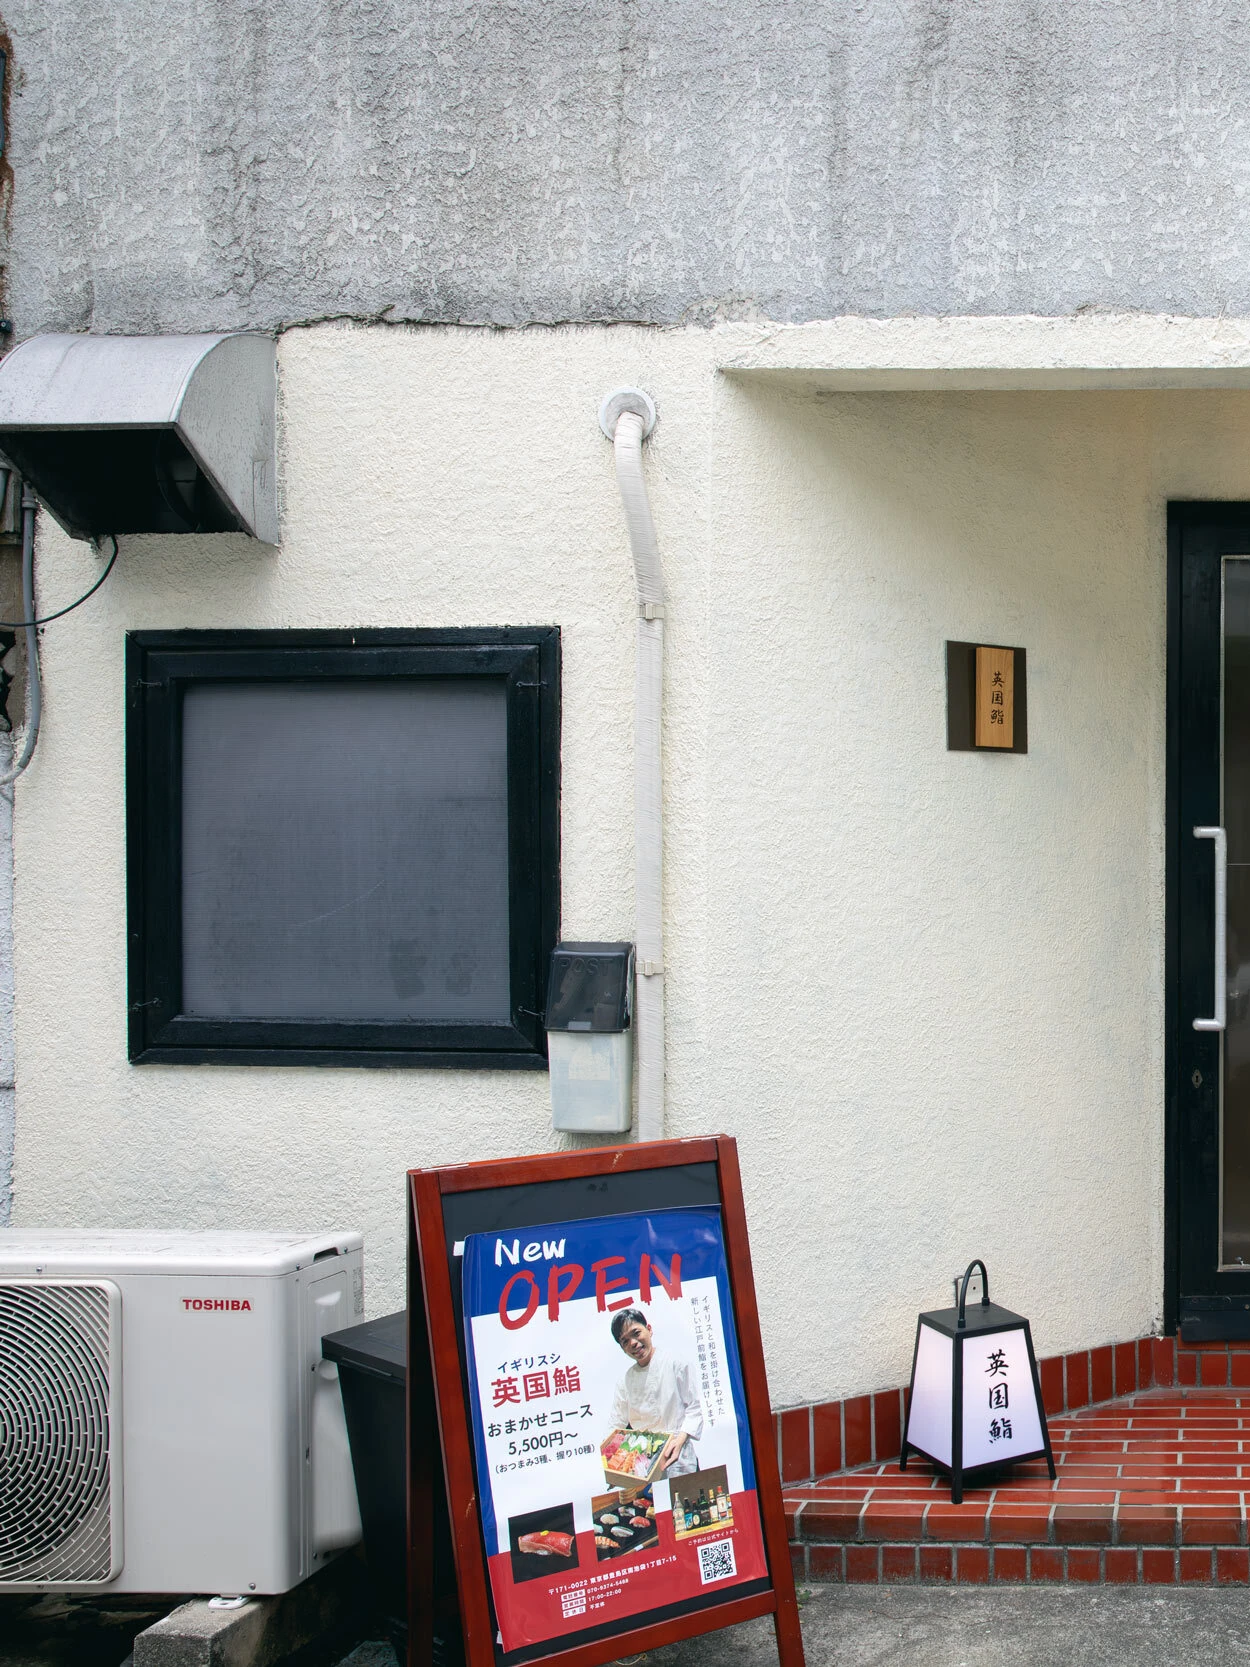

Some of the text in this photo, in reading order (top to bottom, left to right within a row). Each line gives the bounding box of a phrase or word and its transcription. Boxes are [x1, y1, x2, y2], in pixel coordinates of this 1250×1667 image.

[991, 671, 1005, 725] 英国鮨
[558, 957, 614, 976] POST
[494, 1238, 566, 1267] New
[182, 1299, 252, 1311] TOSHIBA
[498, 1253, 683, 1331] OPEN
[497, 1353, 561, 1373] イギリスシ
[702, 1296, 725, 1415] イギリスと和を掛け合わせた
[491, 1365, 581, 1408] 英国鮨
[984, 1349, 1012, 1444] 英国鮨
[488, 1404, 593, 1437] おまかせコース
